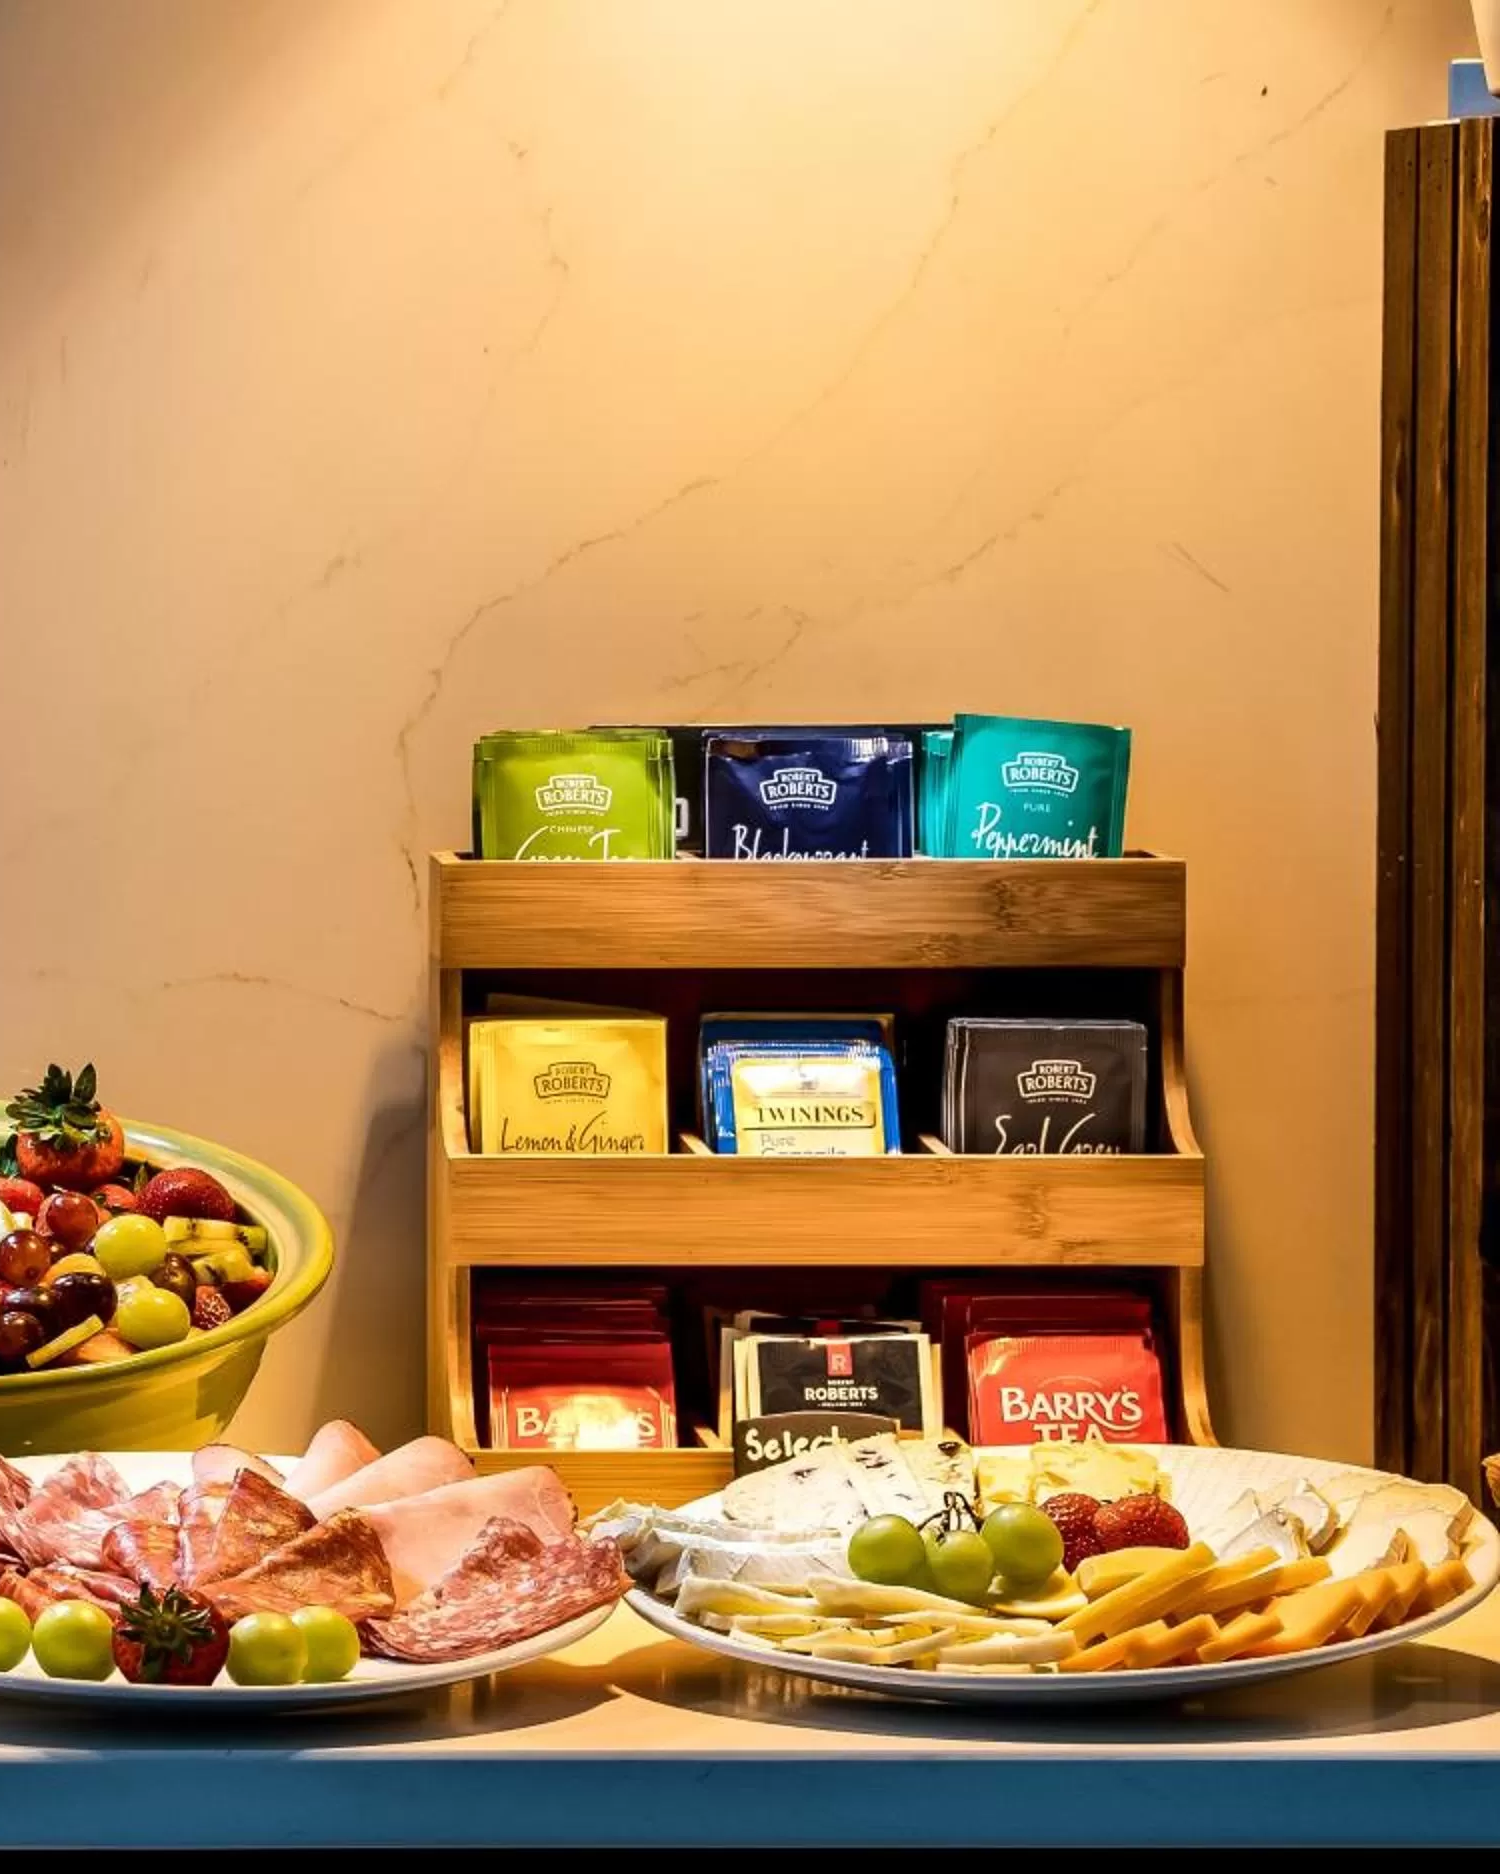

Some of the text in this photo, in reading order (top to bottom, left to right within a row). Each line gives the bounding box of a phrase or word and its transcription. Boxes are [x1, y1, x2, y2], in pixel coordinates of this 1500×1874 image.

[781, 772, 816, 782] ROBERT
[1009, 766, 1071, 786] ROBERTS
[543, 788, 605, 805] ROBERTS
[767, 782, 829, 799] ROBERTS
[1023, 803, 1051, 812] PURE
[550, 825, 594, 833] CHINESE
[971, 801, 1099, 858] Peppermint
[1039, 1065, 1076, 1075] ROBERT
[542, 1075, 604, 1092] ROBERTS
[1025, 1074, 1089, 1092] ROBERTS
[756, 1106, 865, 1123] TWININGS
[501, 1116, 563, 1151] Lemon
[577, 1110, 645, 1154] Ginger
[760, 1133, 795, 1147] Pure
[804, 1386, 879, 1401] ROBERTS
[1000, 1385, 1143, 1424] BARRY'S
